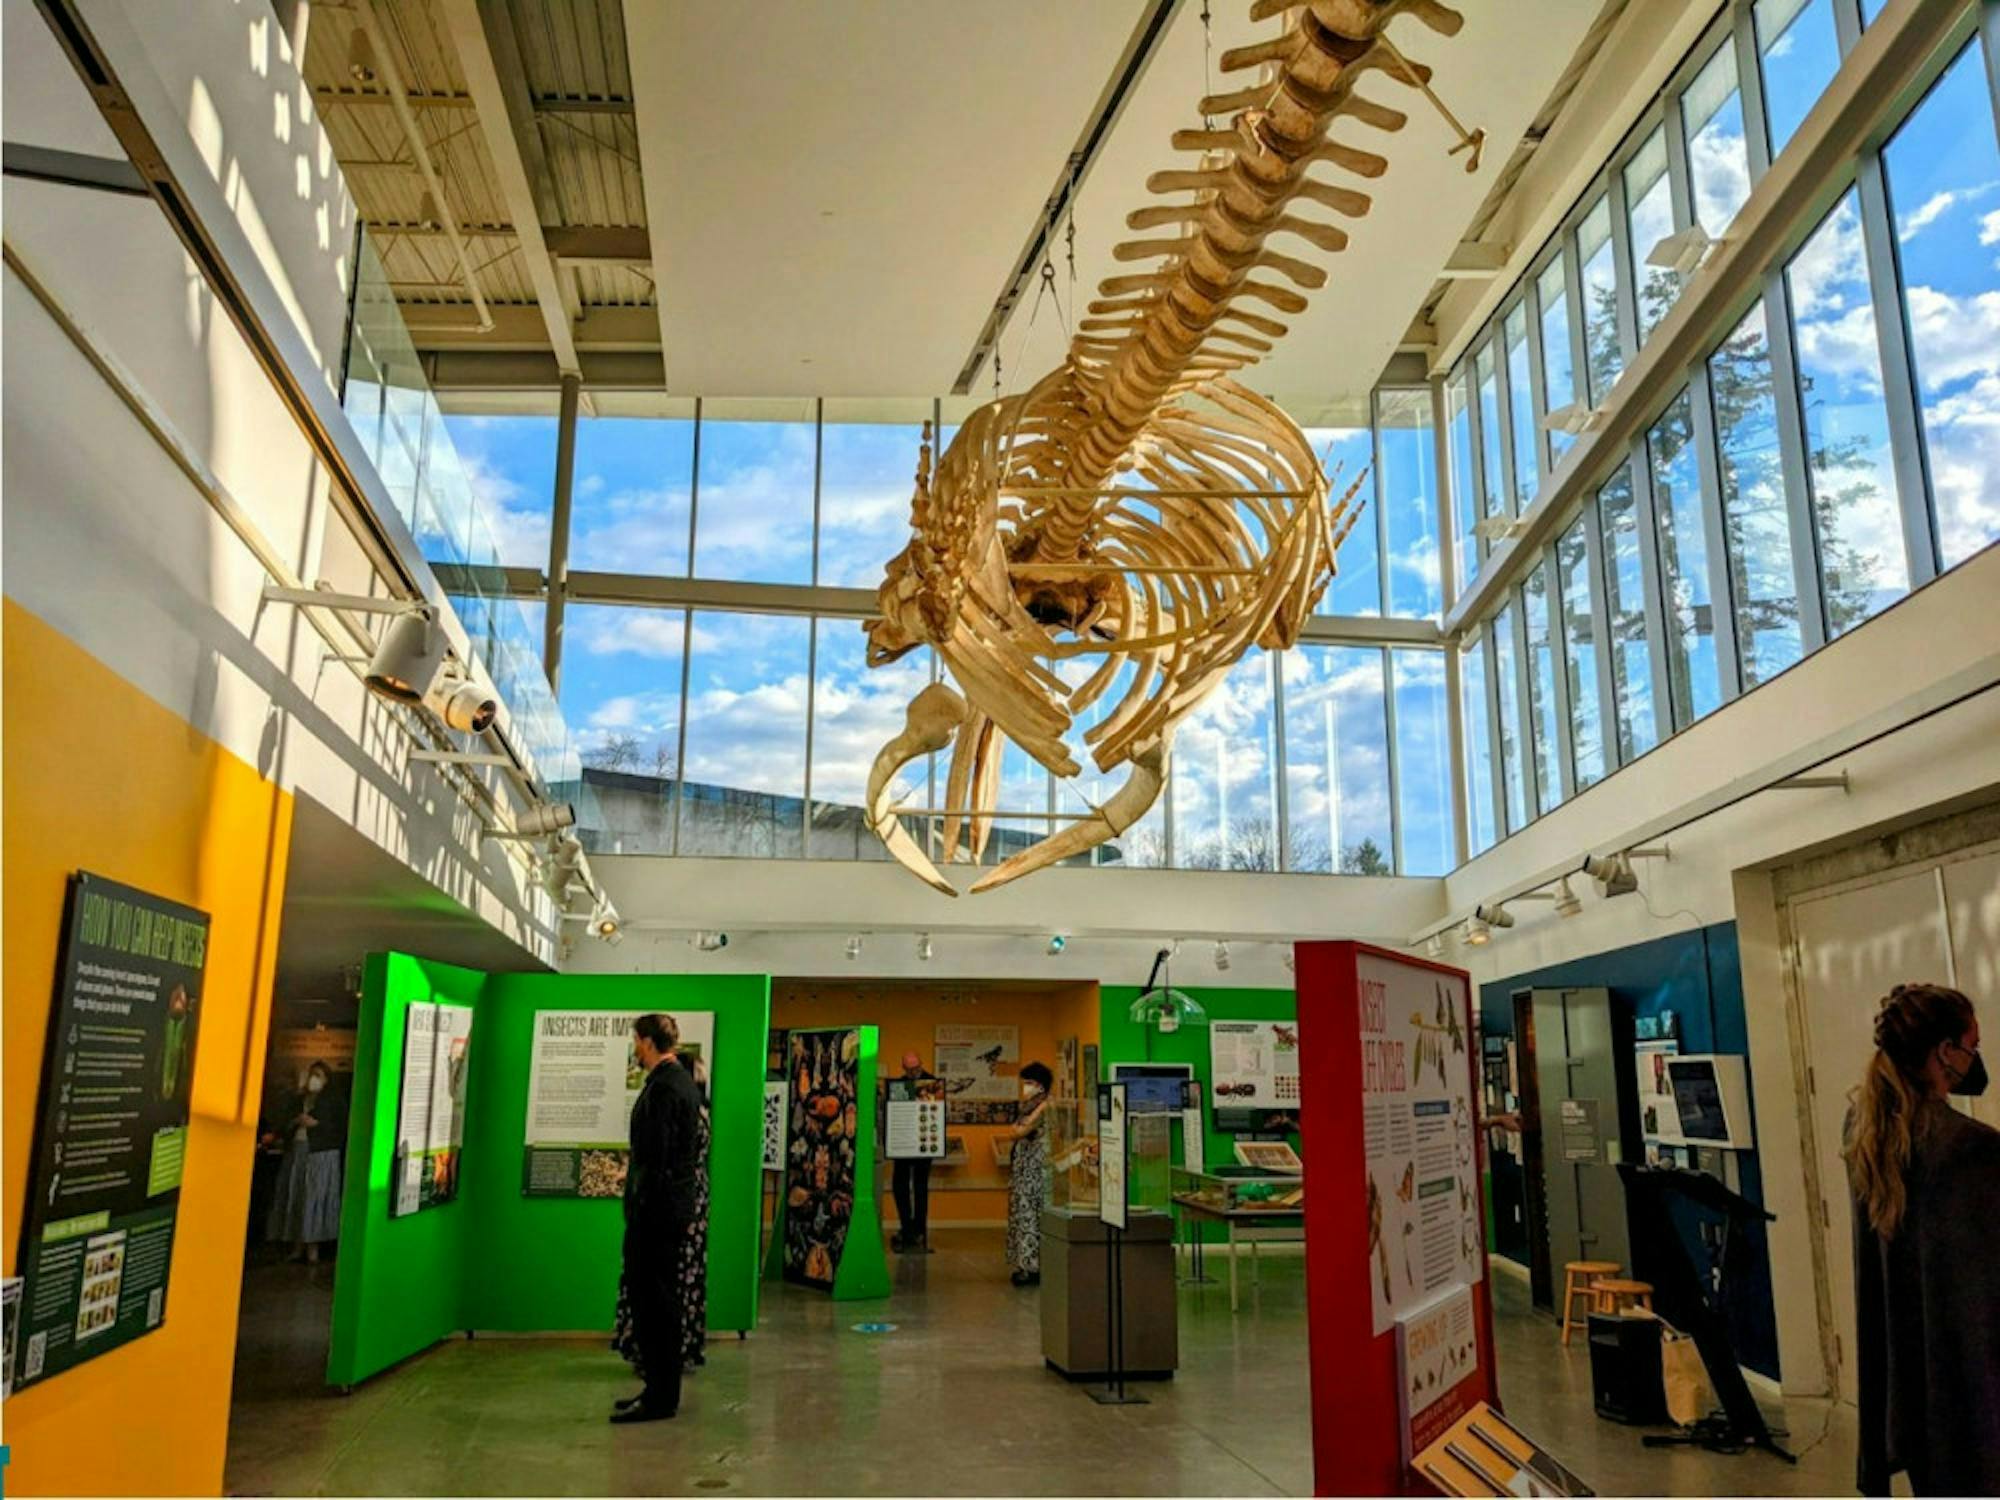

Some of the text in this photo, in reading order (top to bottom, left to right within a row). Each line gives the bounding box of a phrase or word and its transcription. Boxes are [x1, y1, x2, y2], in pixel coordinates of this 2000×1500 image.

[81, 892, 206, 969] HOW YOU CAN HELP INSECTS
[542, 1016, 636, 1037] INSECTS ARE IMP
